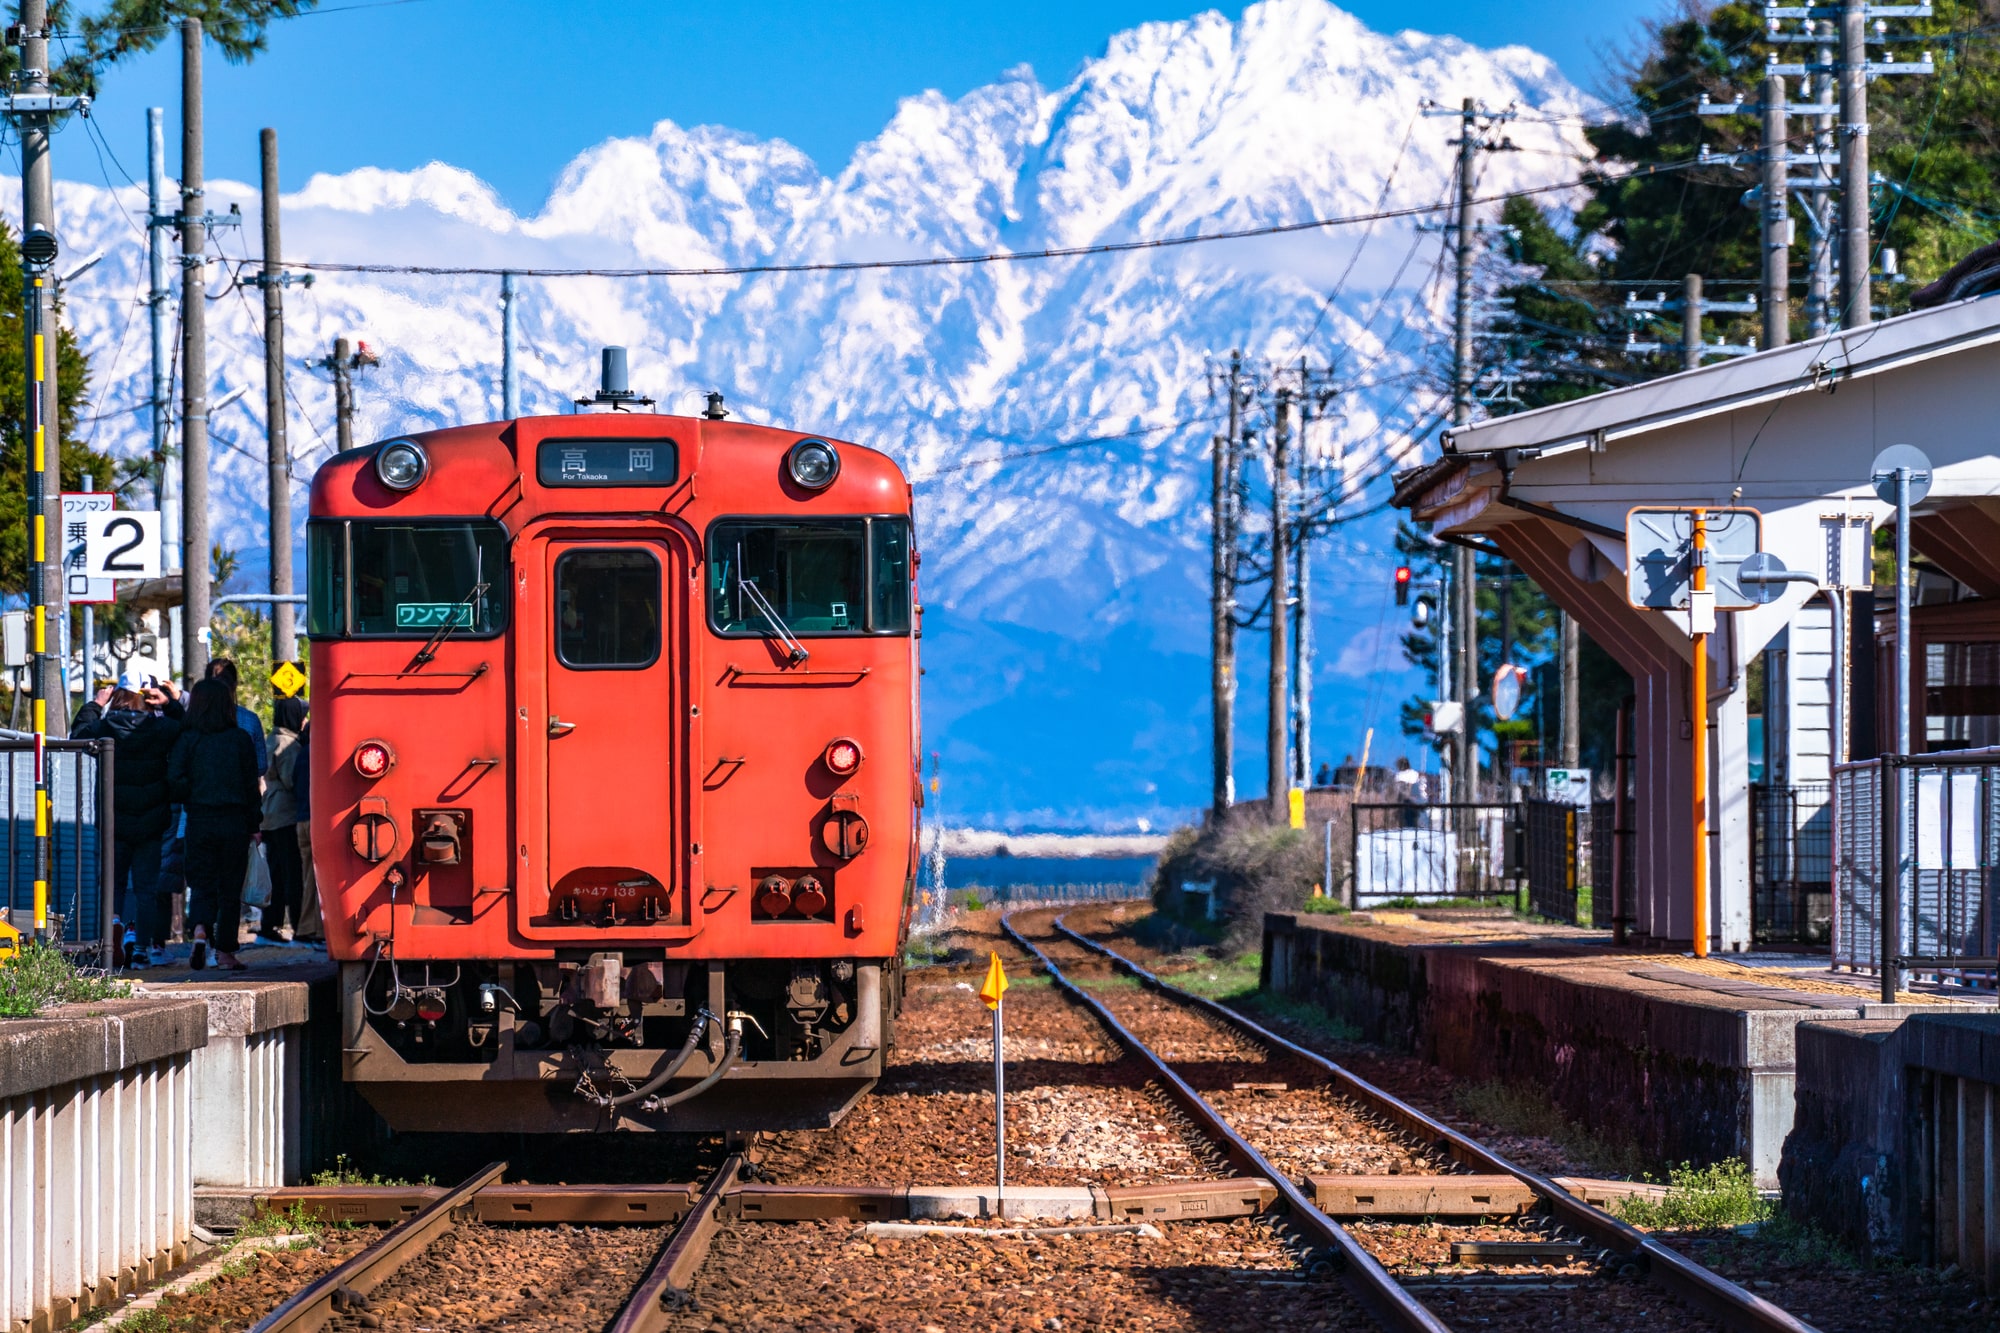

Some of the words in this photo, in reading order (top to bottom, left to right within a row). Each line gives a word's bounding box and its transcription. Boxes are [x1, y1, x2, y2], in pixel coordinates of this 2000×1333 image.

[64, 500, 111, 512] ワンマン
[102, 517, 145, 571] 2
[400, 607, 467, 623] ワンマン
[282, 670, 294, 689] 3
[573, 887, 608, 896] キハ47
[614, 887, 636, 897] 138
